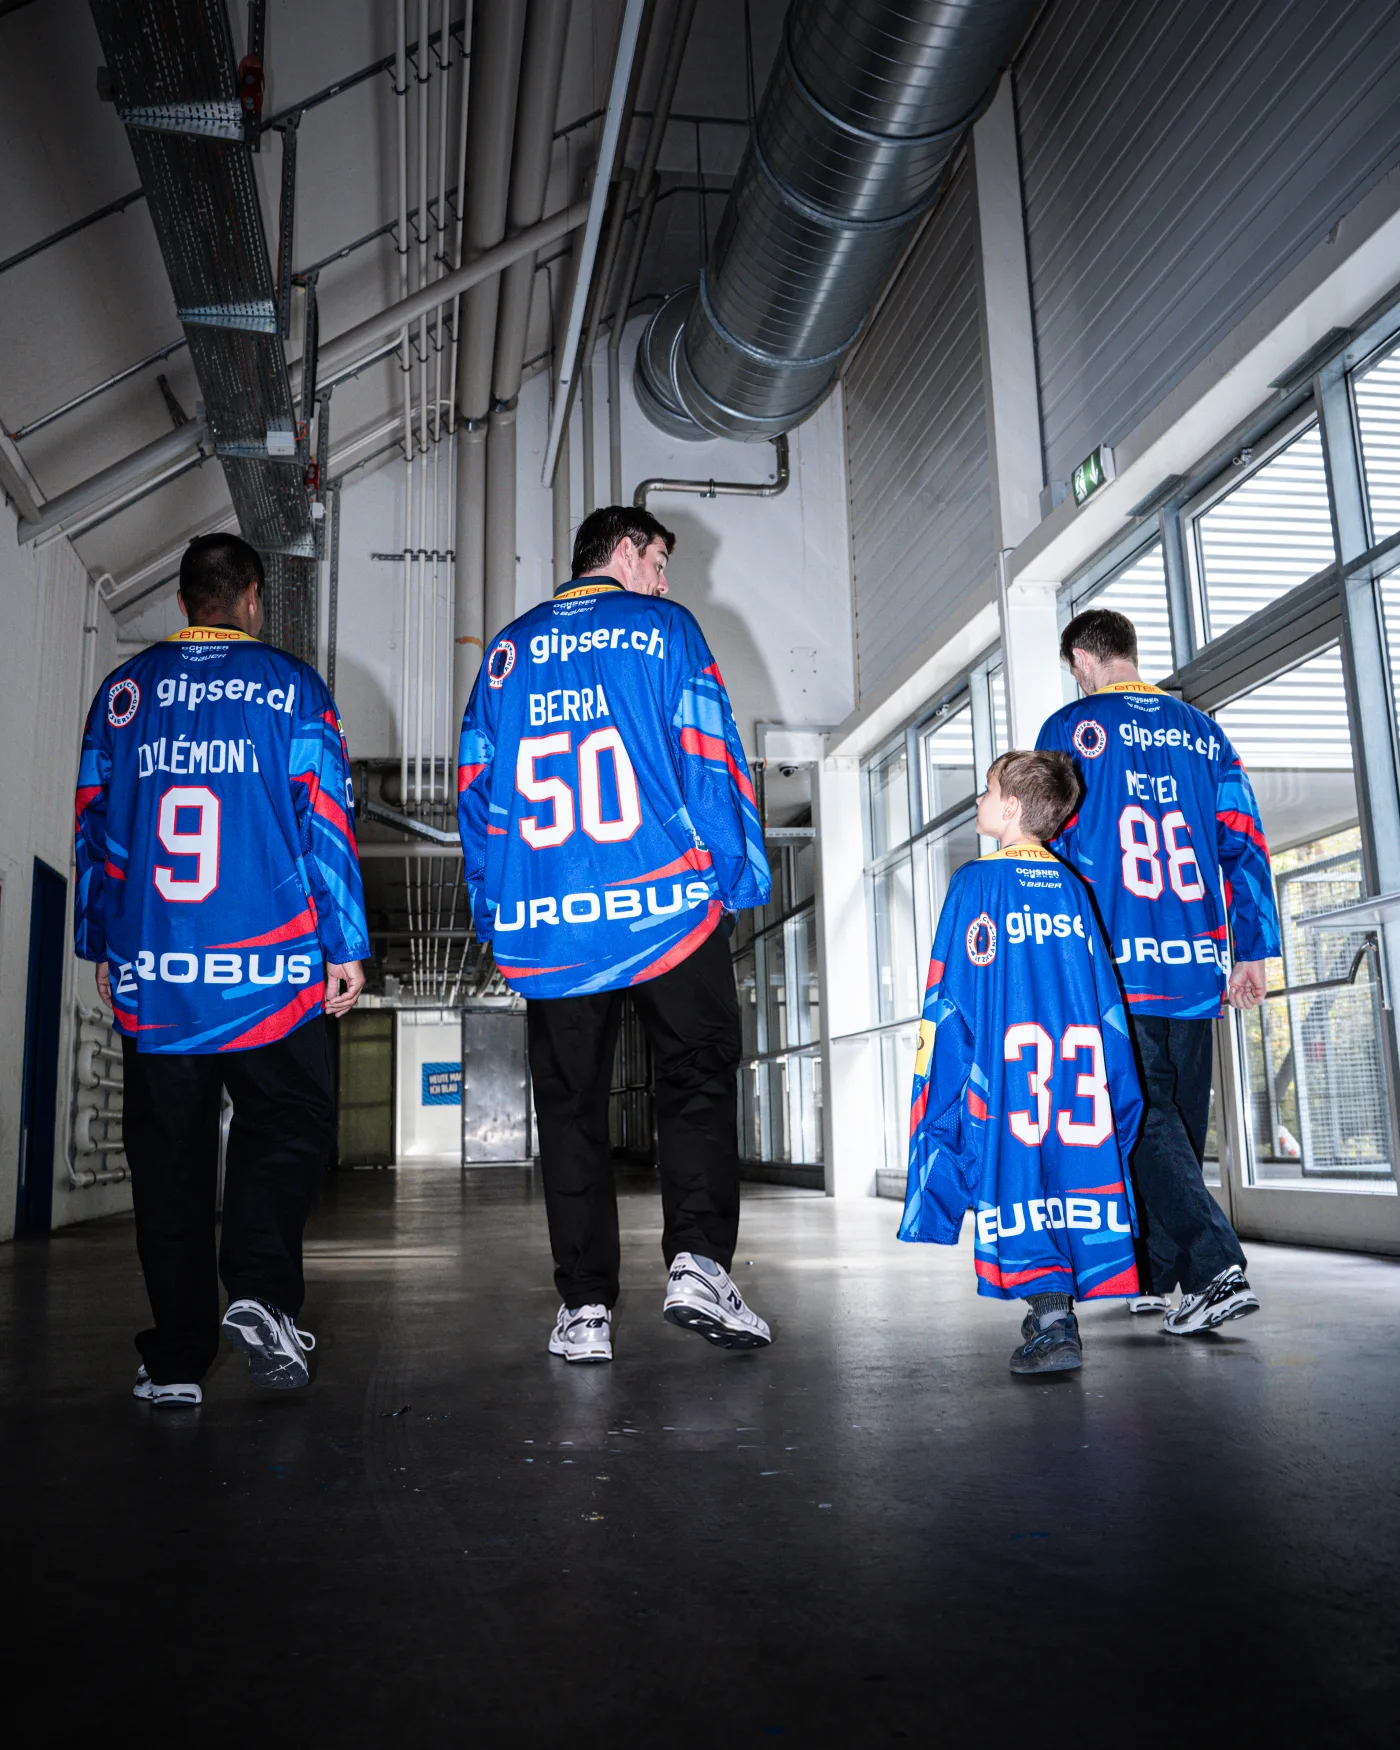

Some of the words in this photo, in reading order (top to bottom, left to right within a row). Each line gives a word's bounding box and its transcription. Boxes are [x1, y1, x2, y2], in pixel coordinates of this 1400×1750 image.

[530, 628, 664, 664] gipser.ch
[529, 684, 610, 726] BERRA
[1119, 719, 1221, 761] gipser.ch
[515, 726, 642, 851] 50
[153, 785, 221, 903] 9
[1016, 868, 1059, 877] OCHSNER
[1118, 804, 1206, 903] 88
[1003, 1022, 1115, 1147] 33
